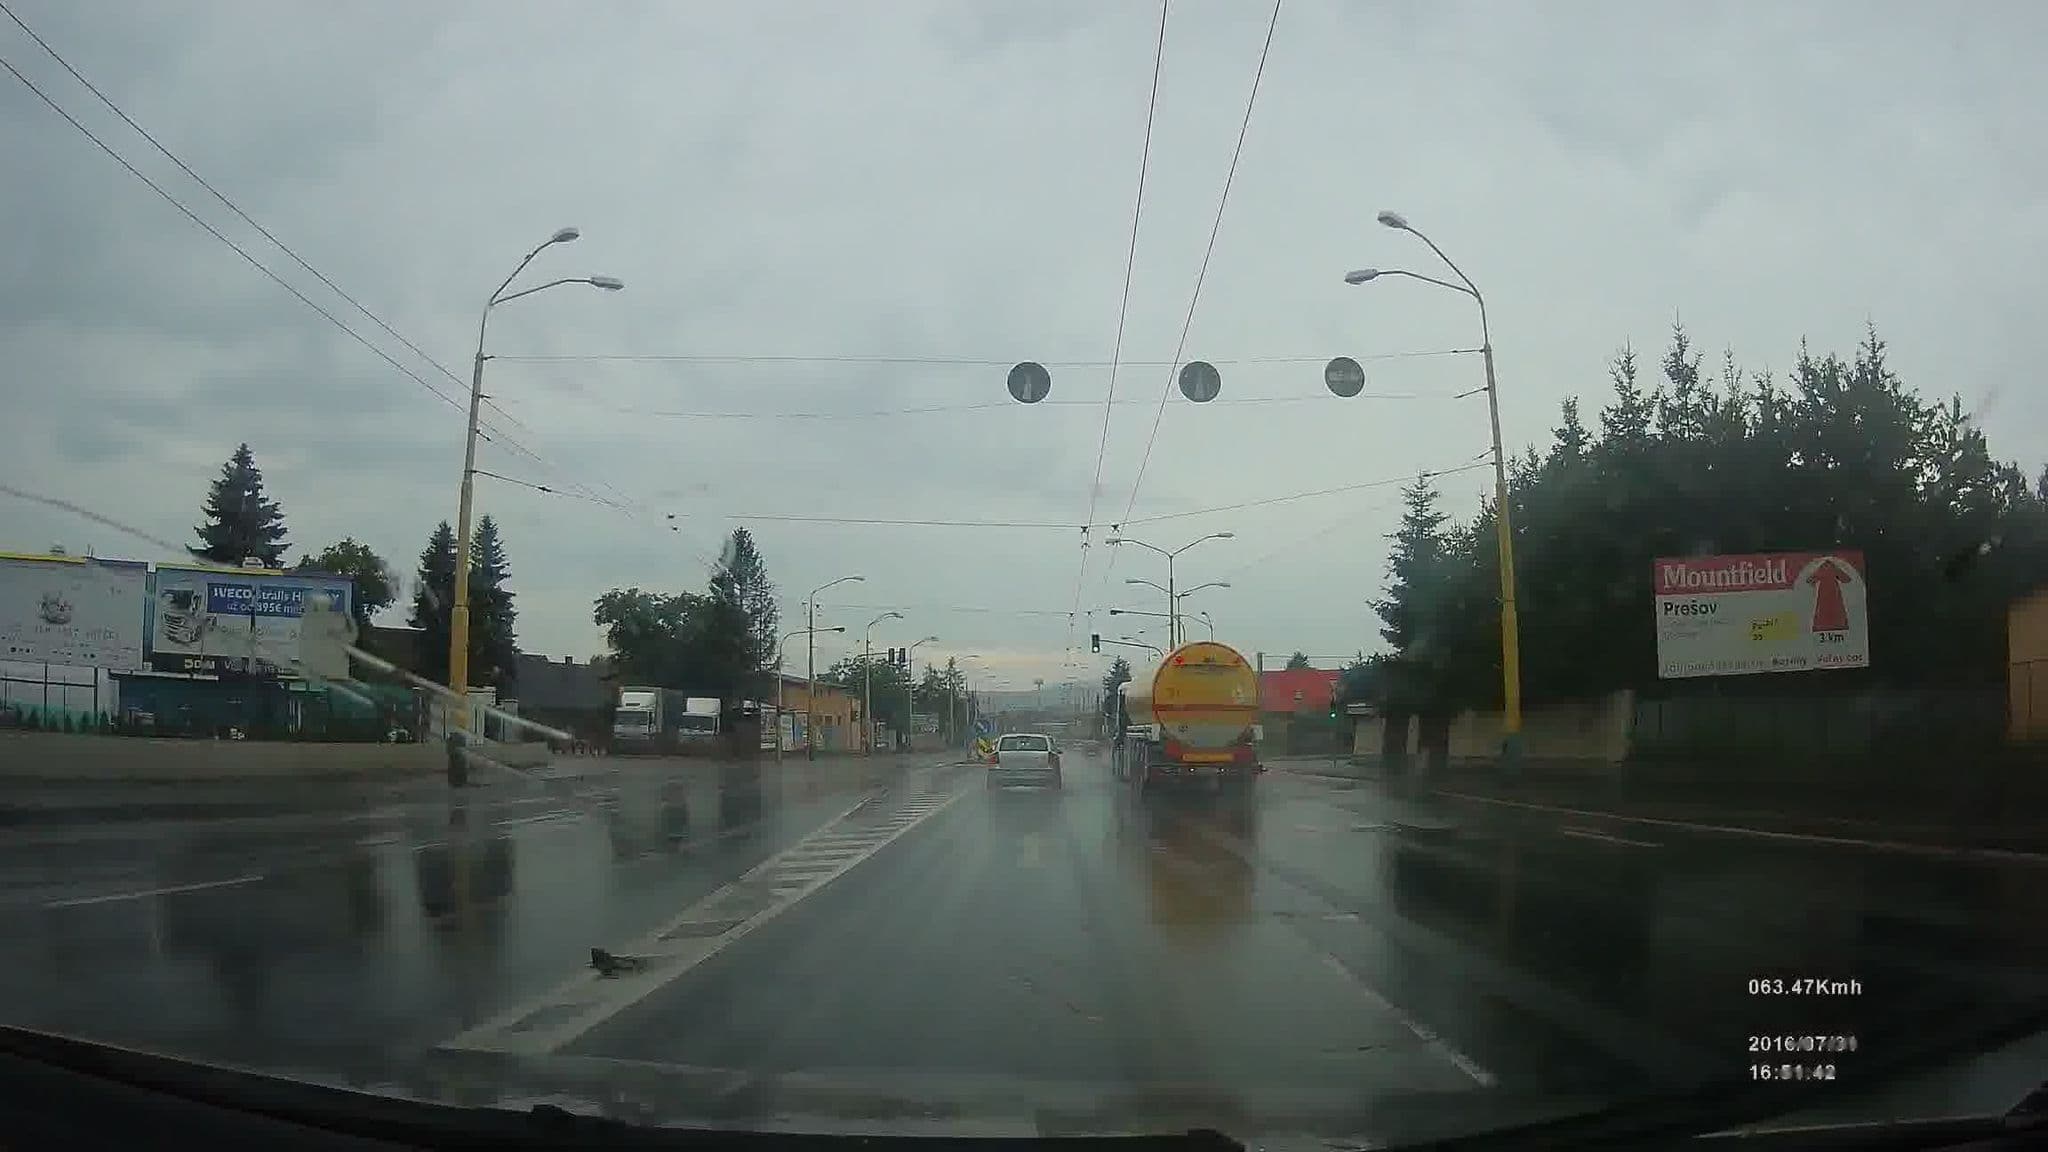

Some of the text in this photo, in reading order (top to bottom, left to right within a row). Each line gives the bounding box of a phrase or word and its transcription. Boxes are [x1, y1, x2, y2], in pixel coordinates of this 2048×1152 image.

[1663, 559, 1788, 589] Mountfield
[213, 587, 252, 599] IVECO
[1663, 599, 1717, 616] Prešov
